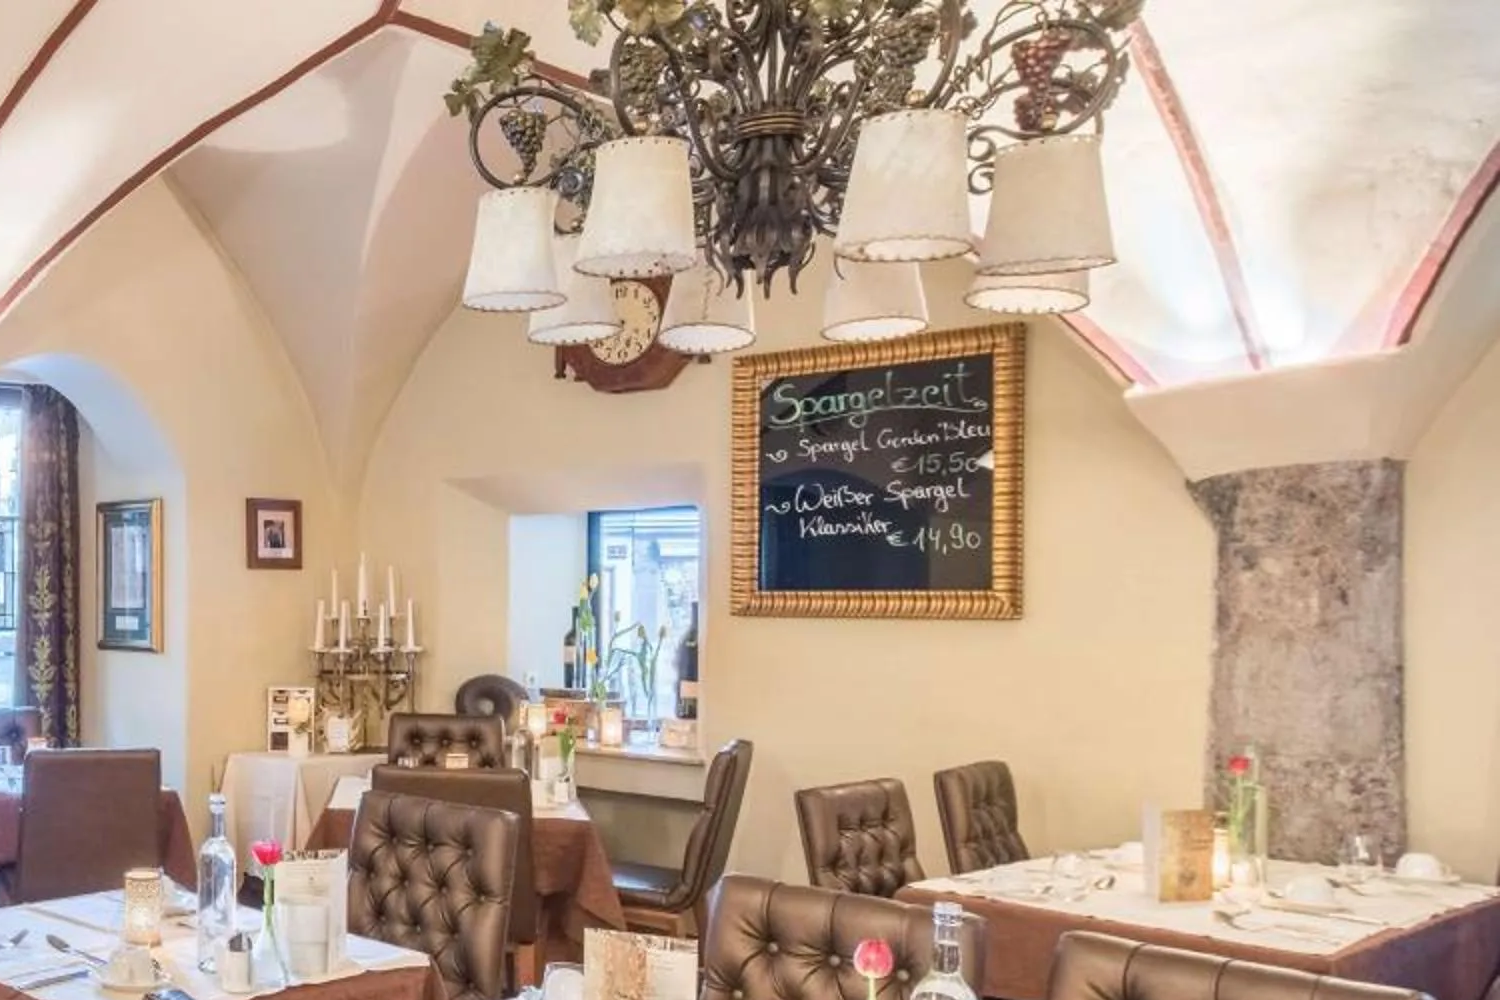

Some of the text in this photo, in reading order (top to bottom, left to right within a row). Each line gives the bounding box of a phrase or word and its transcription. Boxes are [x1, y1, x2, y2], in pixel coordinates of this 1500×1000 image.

[770, 362, 977, 432] Spargelzeit
[796, 430, 871, 463] Spargel
[884, 477, 971, 513] Spargel
